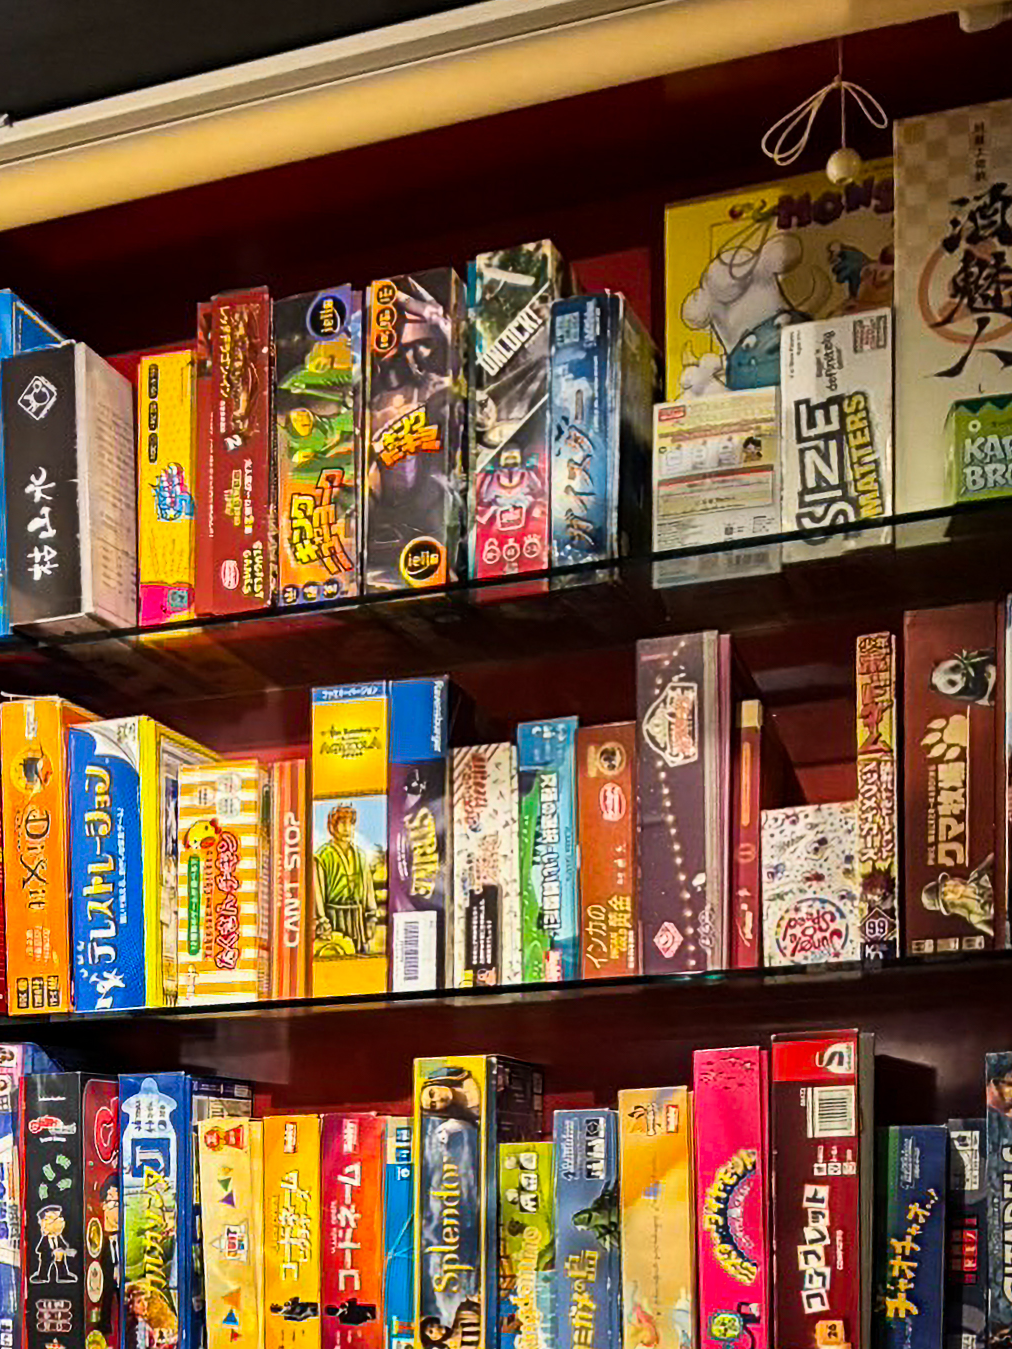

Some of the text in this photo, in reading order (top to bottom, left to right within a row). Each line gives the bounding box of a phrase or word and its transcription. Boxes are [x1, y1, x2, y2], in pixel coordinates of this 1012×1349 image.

[477, 308, 543, 376] UNLOCK!
[845, 390, 885, 519] MATTERS
[24, 466, 59, 582] 枯山水
[937, 761, 967, 867] クマ牧場
[284, 881, 301, 948] CAN'T
[586, 903, 608, 969] インカの
[608, 894, 632, 928] 黄金
[279, 1168, 299, 1282] コードネーム
[337, 1161, 363, 1293] コードネーム
[425, 1155, 475, 1294] Splendor
